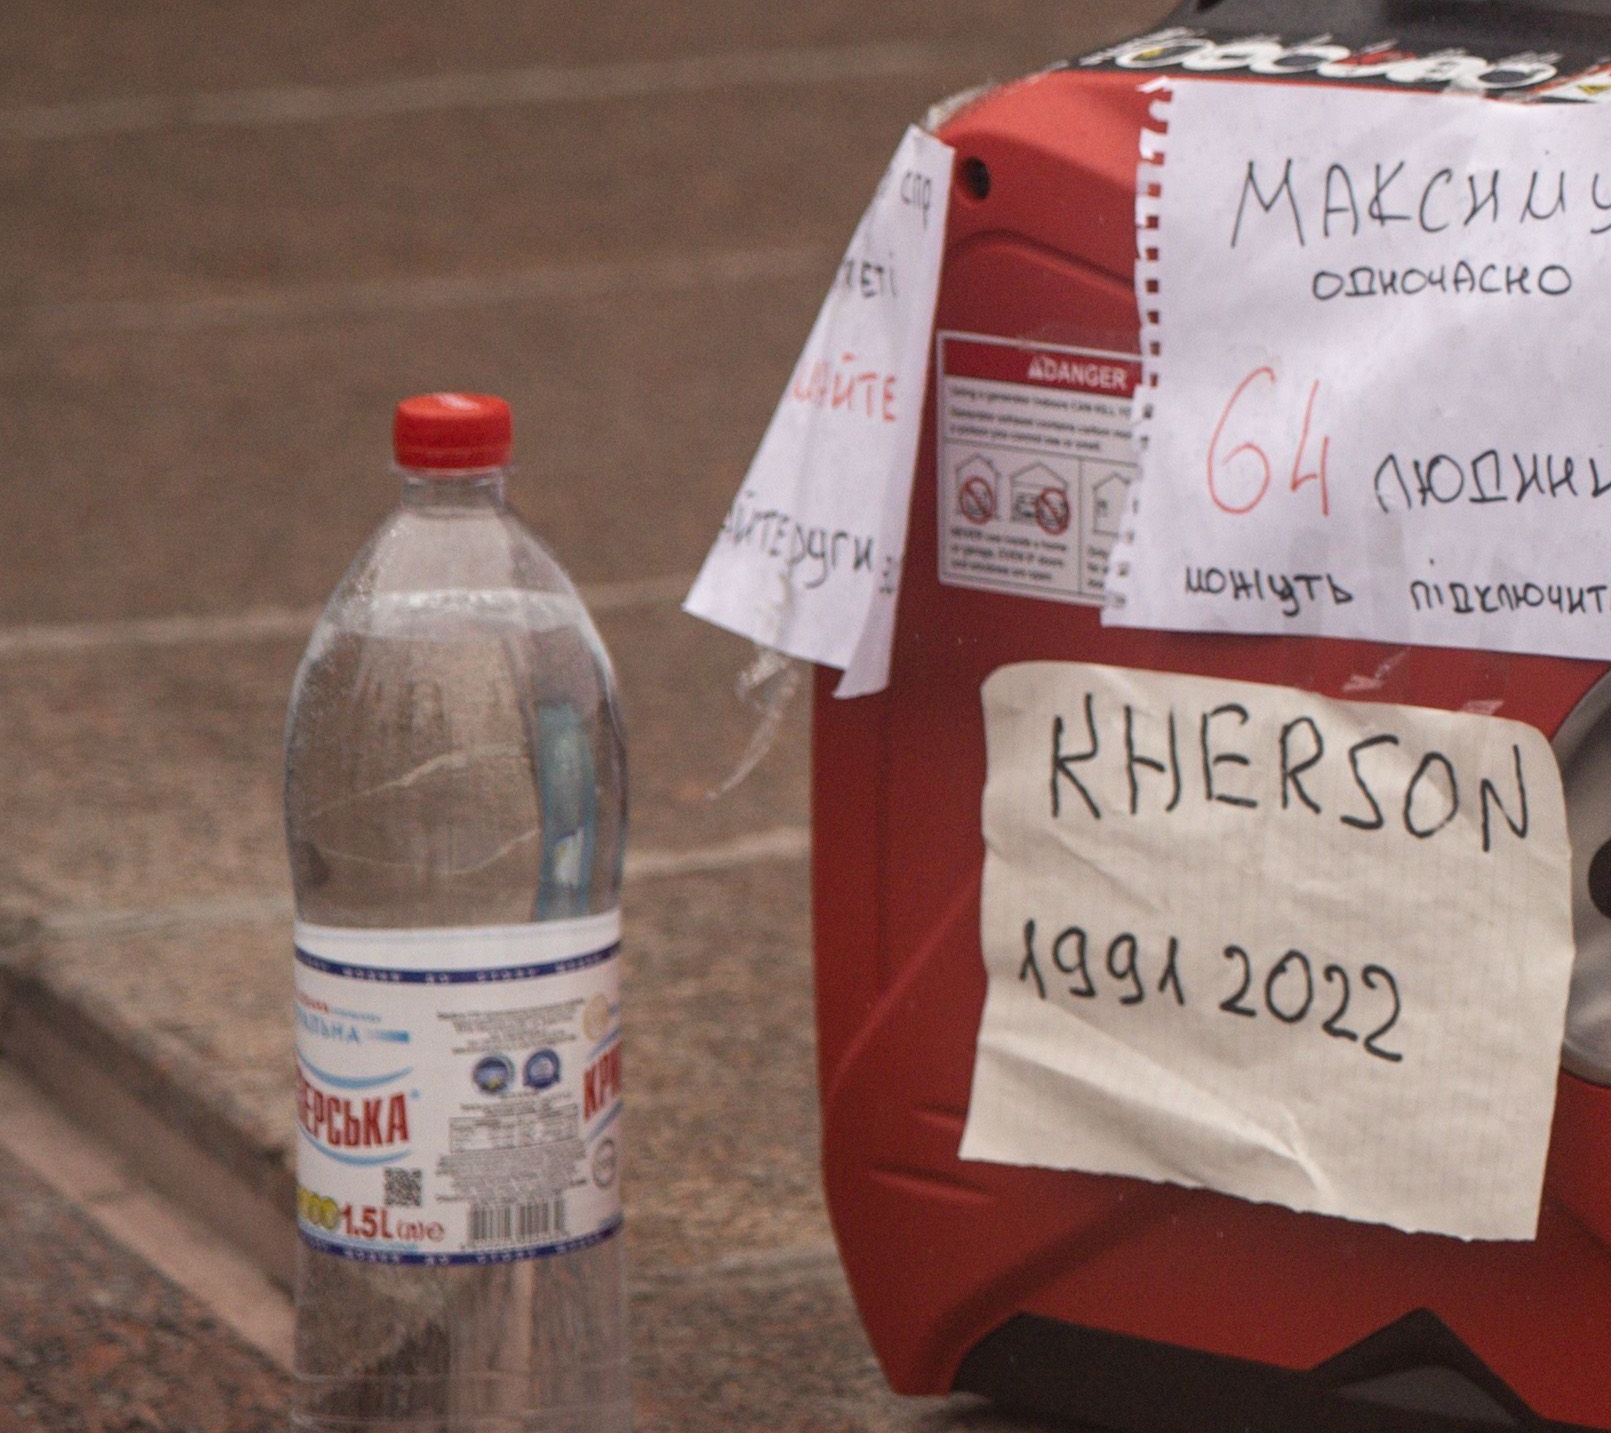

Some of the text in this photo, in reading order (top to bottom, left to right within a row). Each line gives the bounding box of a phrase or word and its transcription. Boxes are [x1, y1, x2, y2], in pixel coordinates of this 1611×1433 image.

[1044, 356, 1128, 390] DANGER
[1205, 365, 1330, 517] 64
[1050, 692, 1529, 853] KHERSON
[1018, 917, 1405, 1062] 1991 2022
